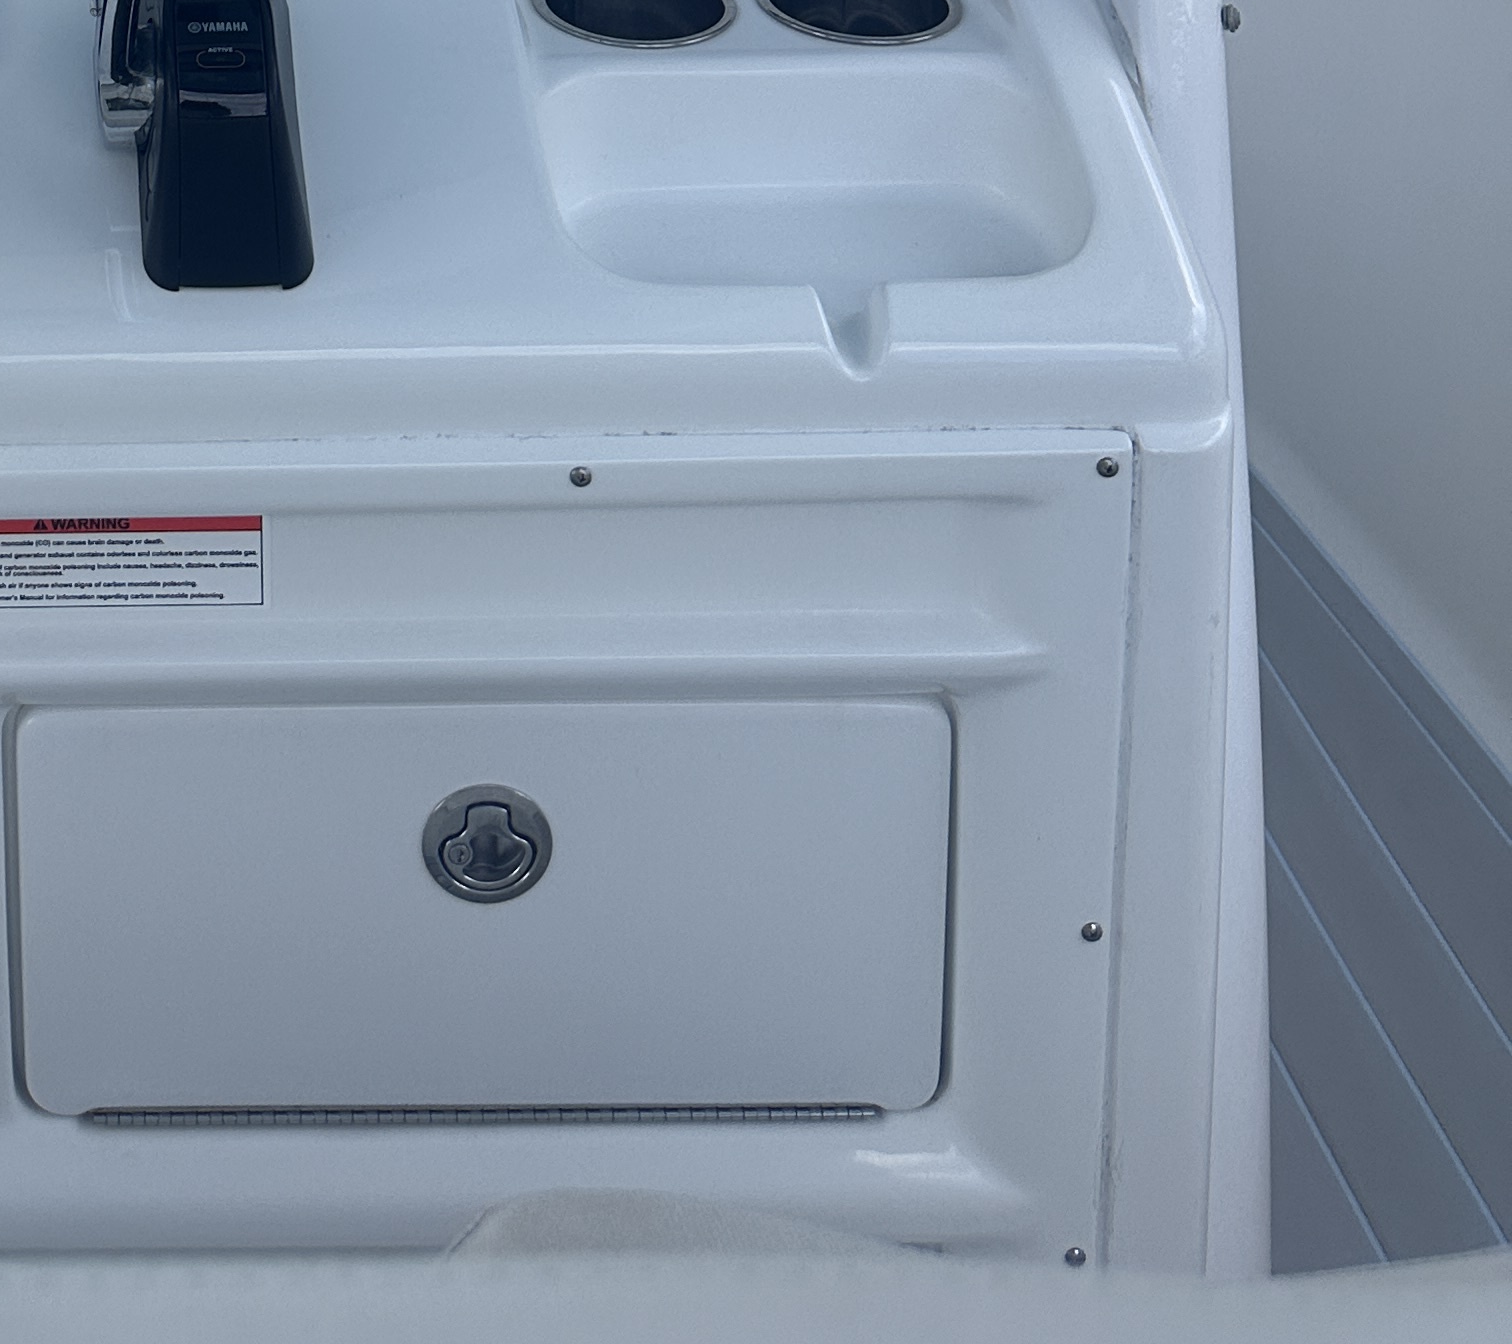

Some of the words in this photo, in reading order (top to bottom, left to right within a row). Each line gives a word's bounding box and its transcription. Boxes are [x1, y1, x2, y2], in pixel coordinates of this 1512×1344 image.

[201, 21, 249, 33] YAMAHA
[50, 518, 130, 531] WARNING
[35, 539, 51, 547] (CO)
[106, 539, 133, 547] damage
[14, 552, 46, 560] generator
[63, 563, 95, 571] poisoning
[219, 561, 259, 569] drowsiness,
[96, 593, 128, 601] regarding
[190, 592, 224, 600] poisoning.
